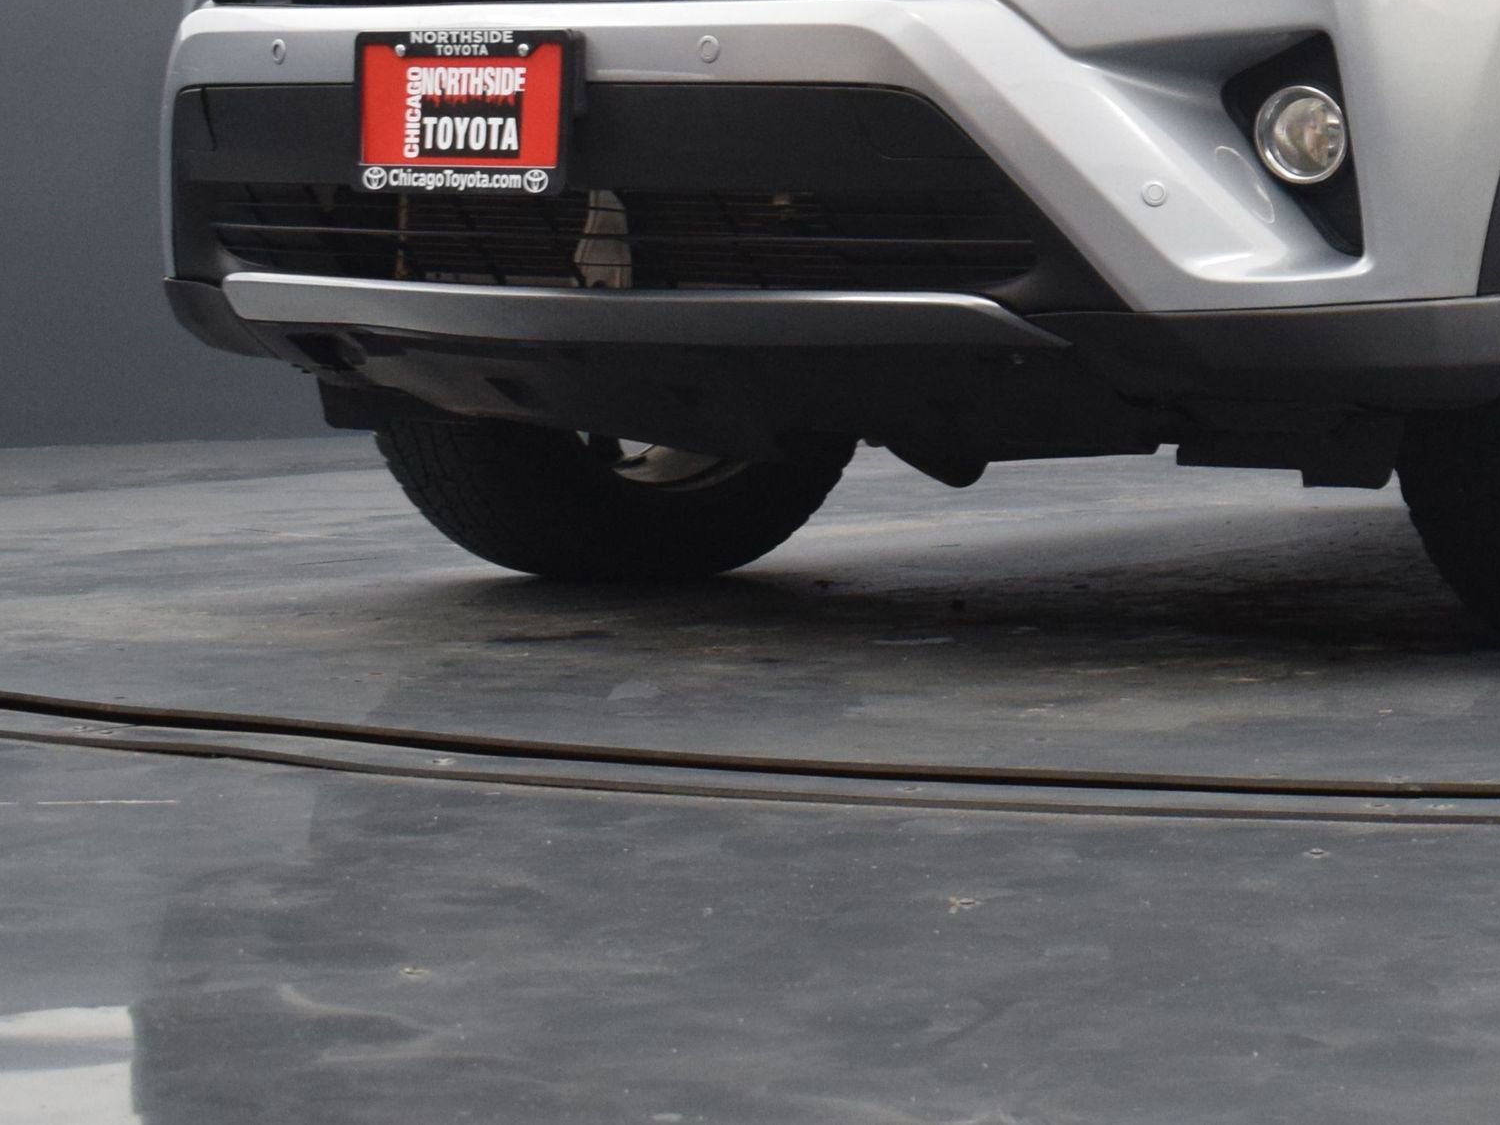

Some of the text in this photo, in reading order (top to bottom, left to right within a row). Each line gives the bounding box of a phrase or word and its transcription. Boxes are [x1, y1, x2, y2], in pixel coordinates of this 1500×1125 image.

[410, 31, 514, 43] NORTHSIDE
[435, 44, 488, 56] TOYOTA
[421, 67, 526, 96] NORTHSIDE
[403, 67, 422, 158] CHICAGO
[423, 117, 519, 151] TOYOTA
[389, 169, 522, 191] ChicagoToyota.com
